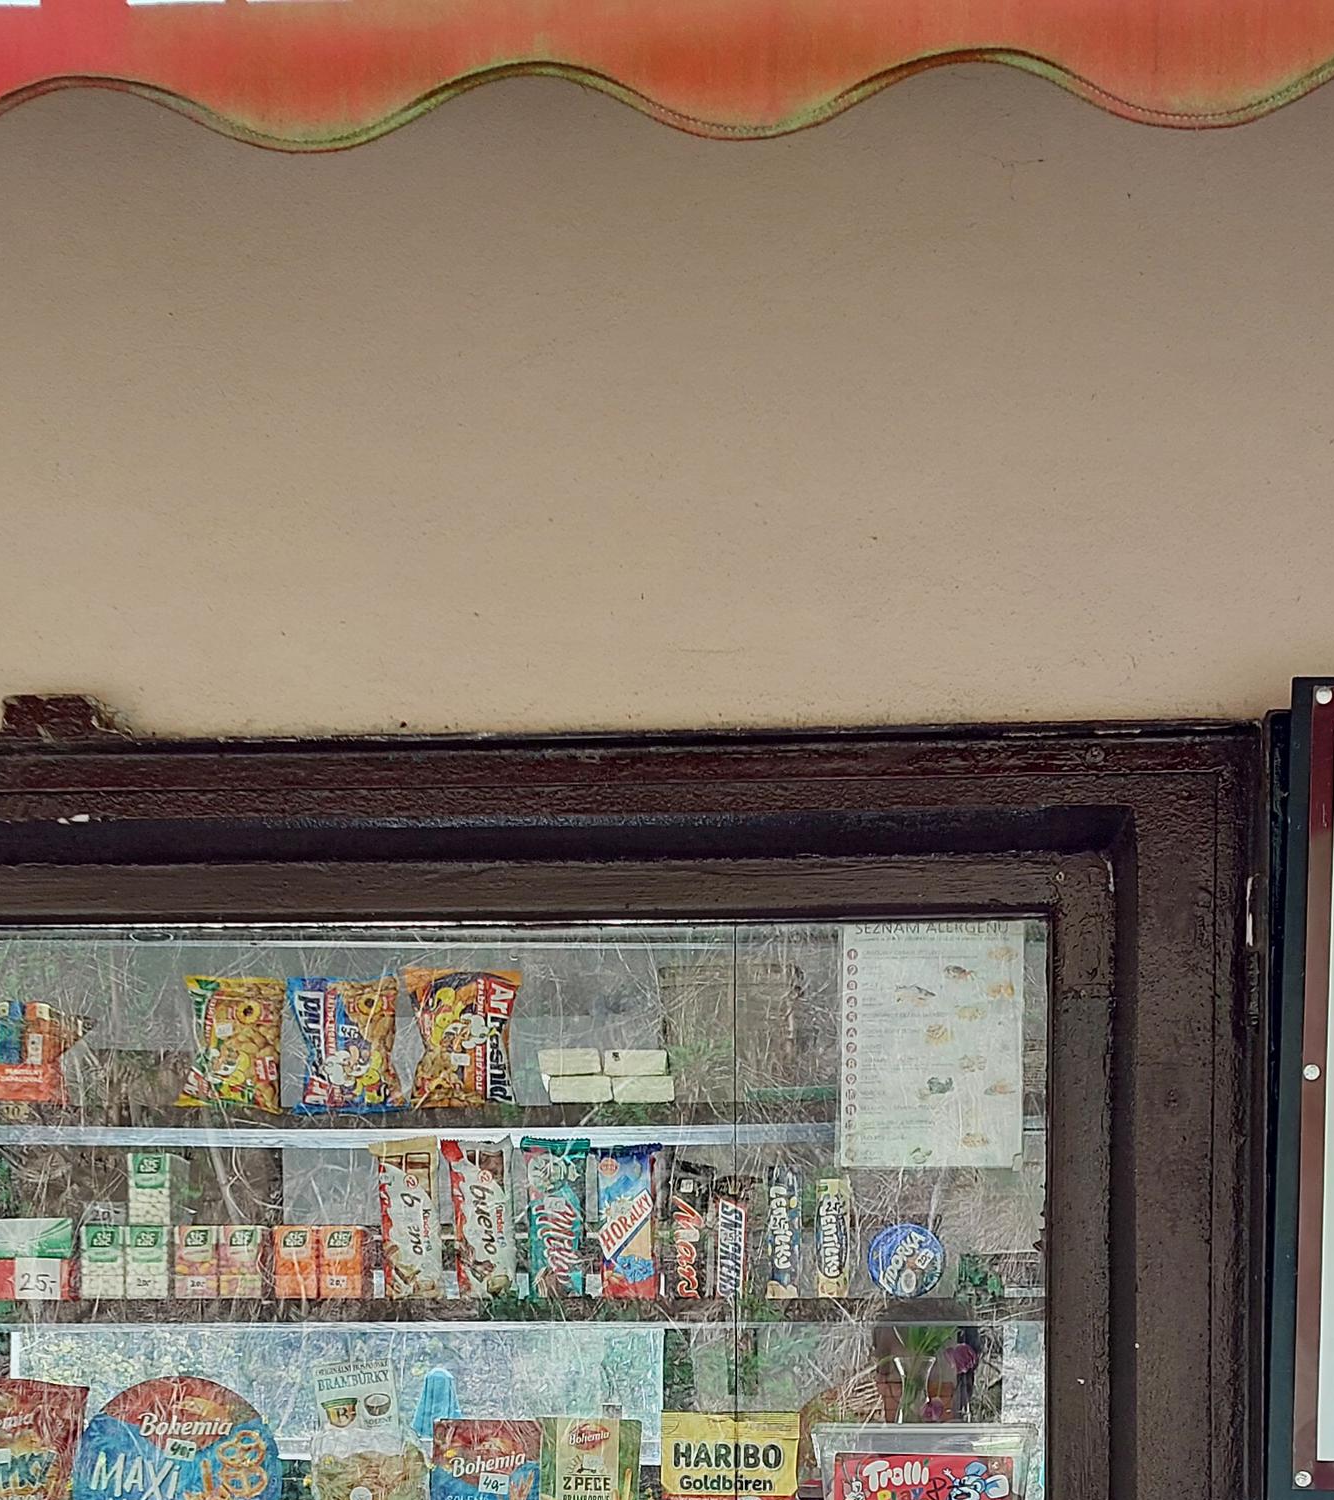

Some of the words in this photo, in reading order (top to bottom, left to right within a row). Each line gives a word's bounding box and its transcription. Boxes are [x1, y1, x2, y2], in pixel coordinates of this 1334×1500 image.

[469, 1184, 498, 1256] bueno
[598, 1189, 653, 1251] HORALKY
[674, 1197, 704, 1299] Mars
[20, 1271, 57, 1293] 25,-
[139, 1412, 233, 1437] Bohemia
[569, 1431, 610, 1445] Bohemia
[450, 1452, 526, 1478] Bohemia
[673, 1443, 782, 1469] HARIBO
[680, 1474, 774, 1493] Goldbären
[863, 1459, 930, 1492] Trolli
